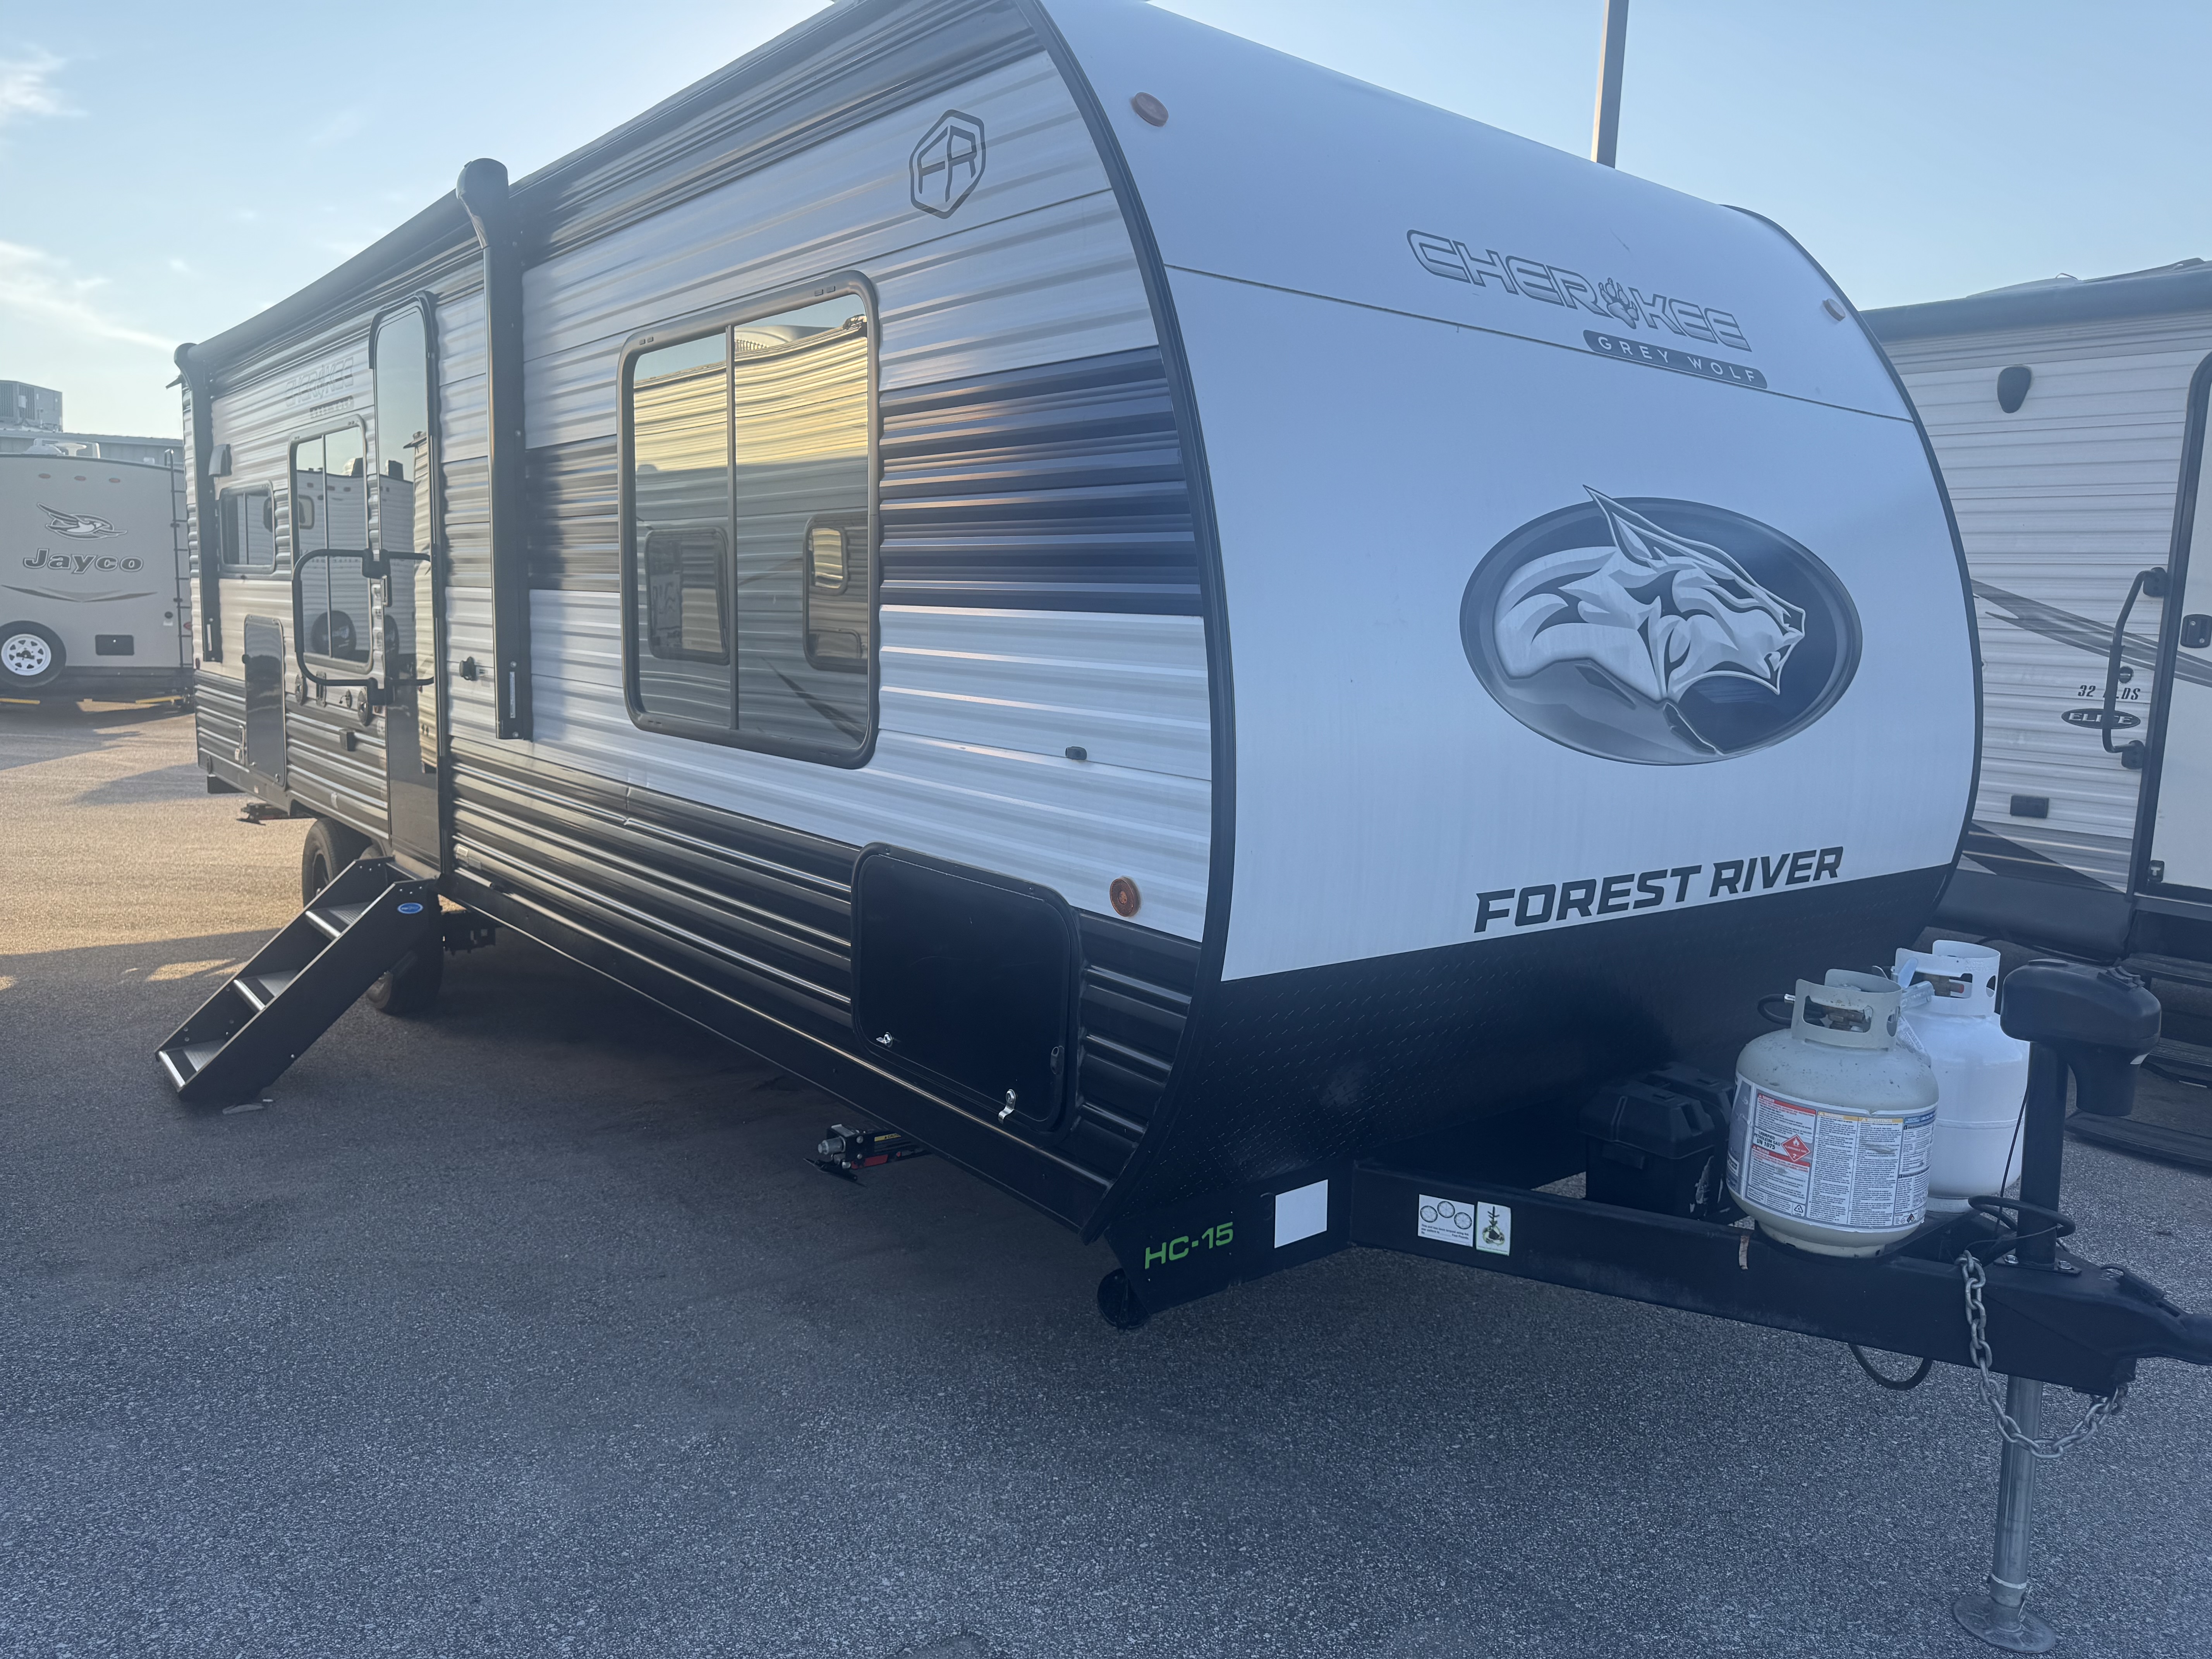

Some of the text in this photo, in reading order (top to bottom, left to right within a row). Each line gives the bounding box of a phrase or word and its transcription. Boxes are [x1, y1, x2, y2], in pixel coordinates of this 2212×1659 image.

[1598, 336, 1754, 382] GREY WOLF
[23, 548, 144, 574] Jayco
[2078, 685, 2096, 697] 32
[2068, 713, 2133, 725] ELIE
[1474, 846, 1844, 933] FOREST RIVER
[1145, 1222, 1233, 1269] HC-15
